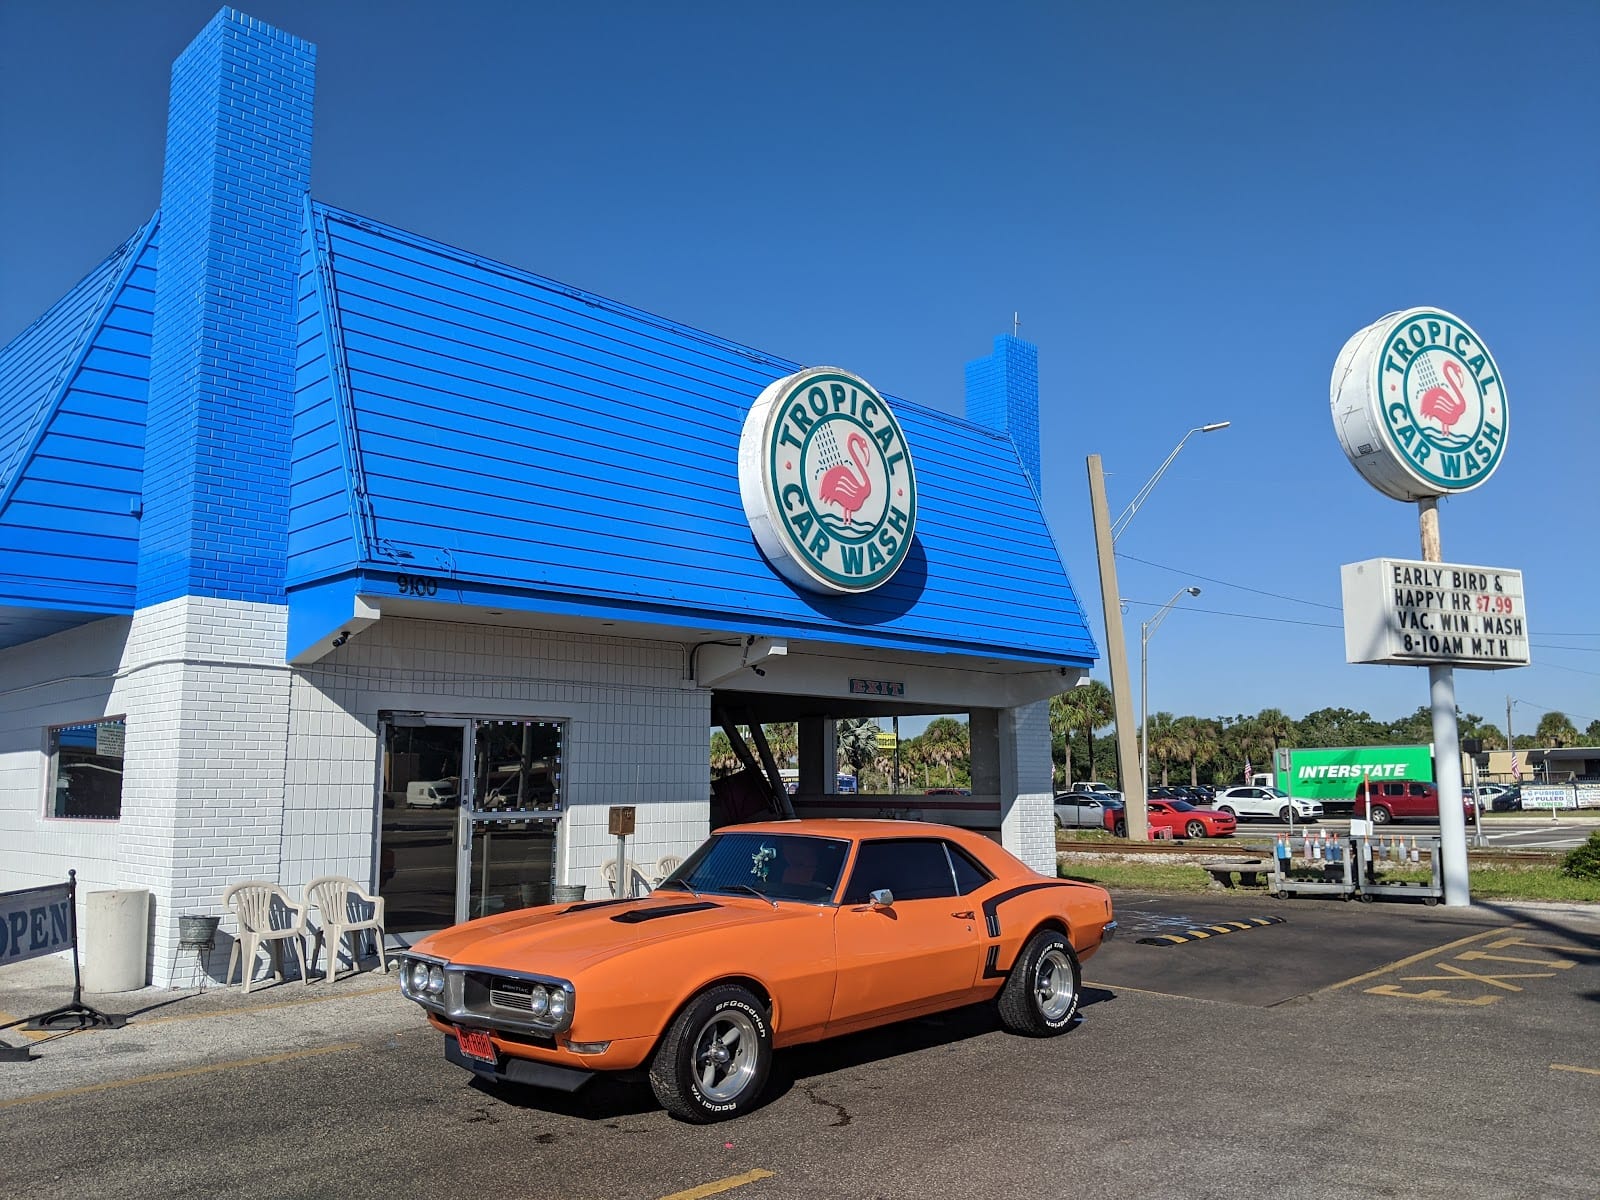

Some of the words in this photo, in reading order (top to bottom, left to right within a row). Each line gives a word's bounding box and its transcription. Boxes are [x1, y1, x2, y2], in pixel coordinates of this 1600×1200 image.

[1385, 321, 1495, 395] TROPICAL
[780, 384, 904, 476] TROPICAL
[1388, 402, 1431, 465] CAR
[1440, 421, 1500, 478] WASH
[782, 483, 830, 561] CAR
[840, 506, 907, 575] WASH
[397, 575, 438, 597] 9100
[1394, 567, 1443, 587] EARLY
[1453, 572, 1487, 591] BIRD
[1494, 575, 1503, 592] &
[1395, 589, 1445, 609] HAPPY
[1453, 594, 1471, 611] HR
[1476, 595, 1513, 614] $7.99
[1398, 611, 1434, 630] VAC.
[1483, 617, 1522, 636] WASH
[1404, 634, 1463, 654] 8-10AM
[853, 680, 901, 696] EXIT
[1298, 763, 1410, 779] INTERSTATE
[702, 1101, 737, 1112] Radial
